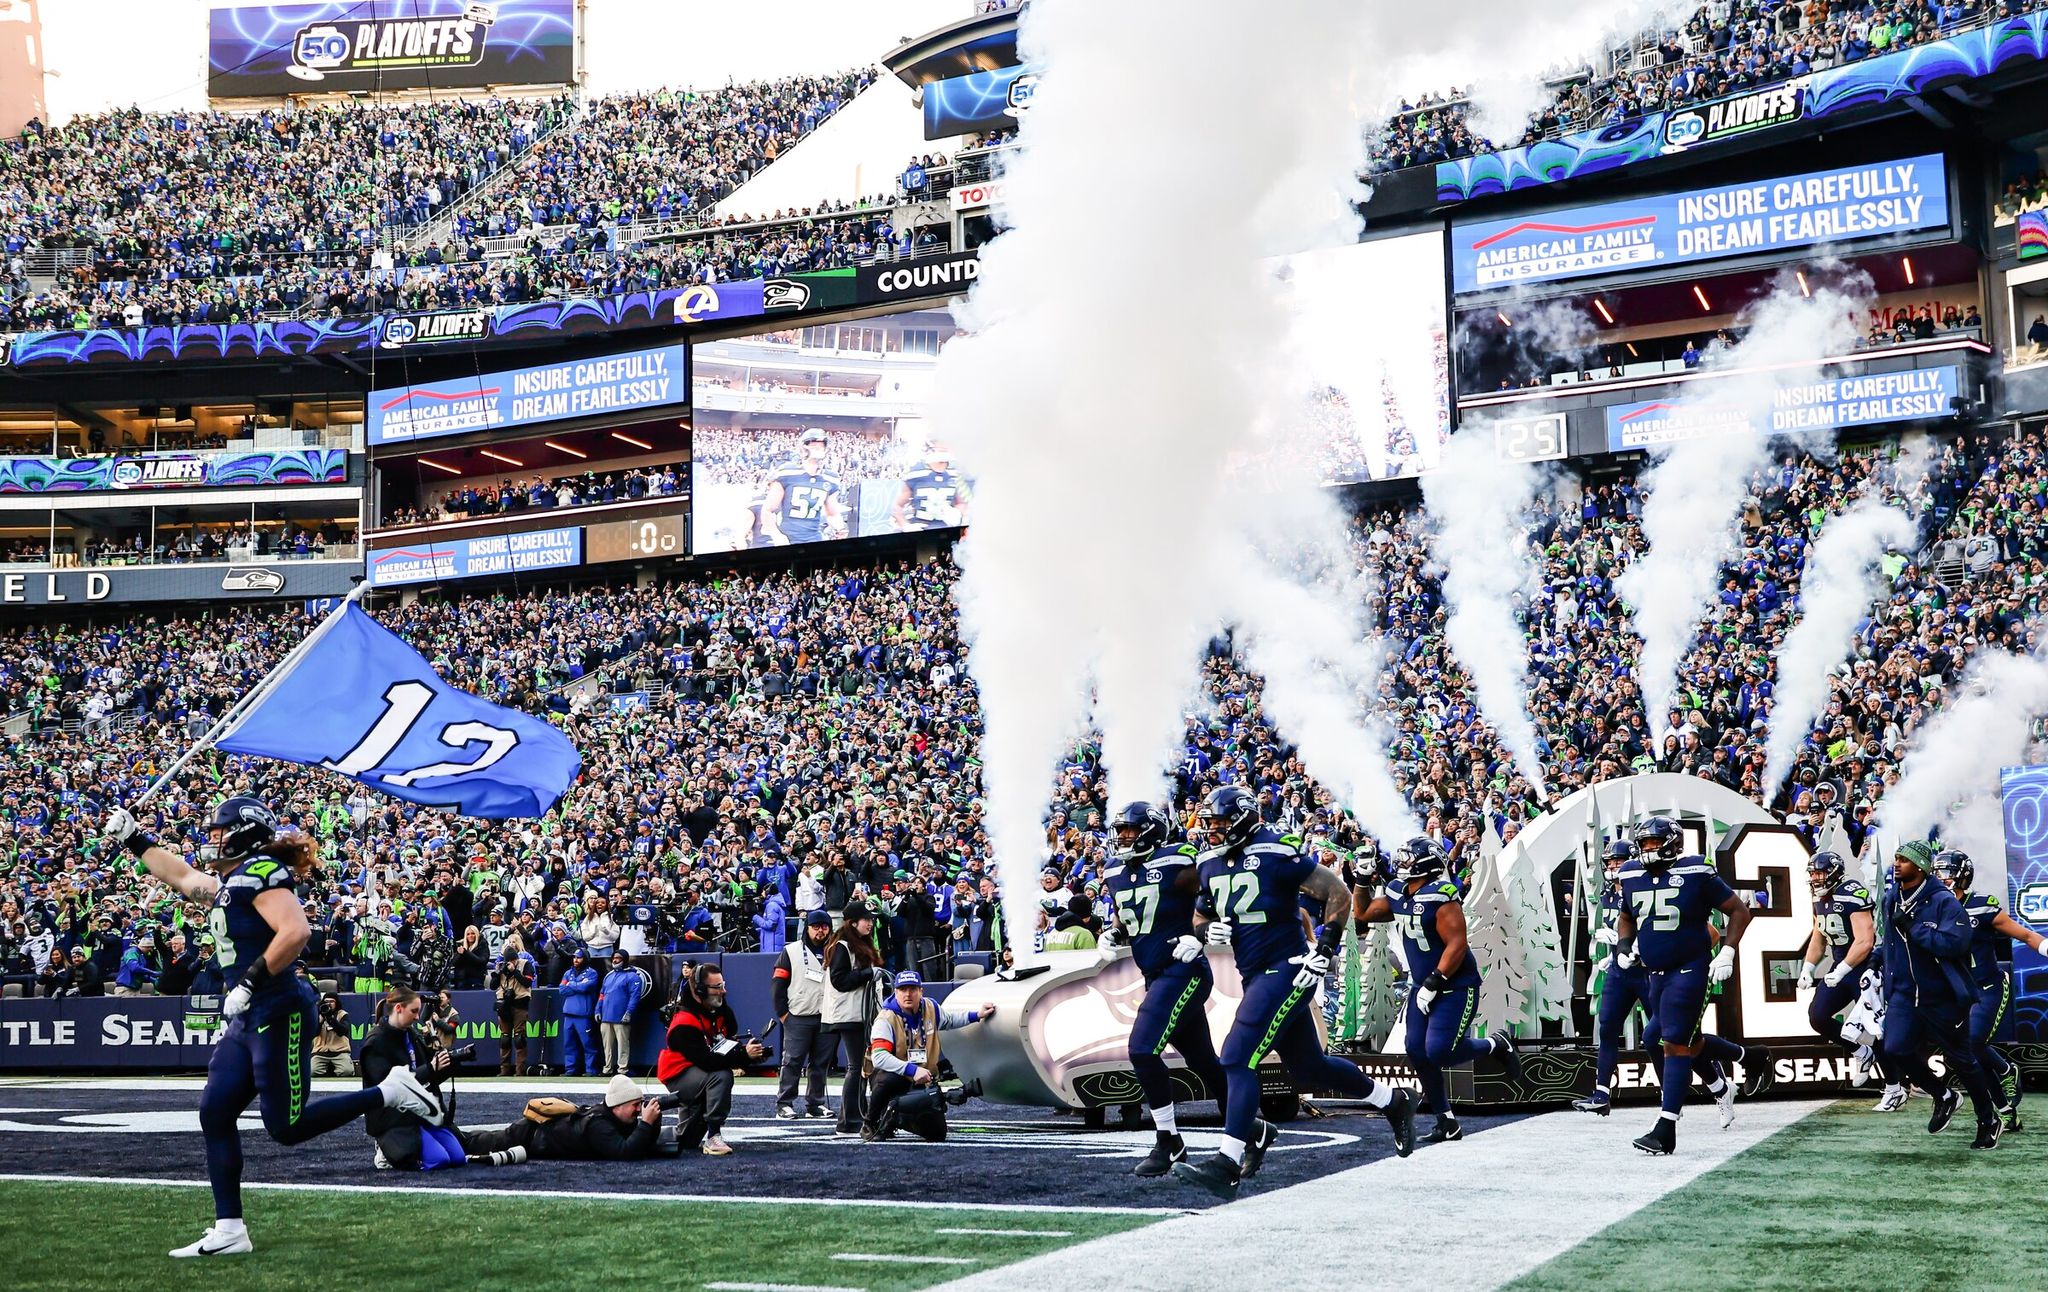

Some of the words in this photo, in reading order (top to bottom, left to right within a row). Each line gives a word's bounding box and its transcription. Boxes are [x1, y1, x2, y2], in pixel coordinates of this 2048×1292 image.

[302, 35, 346, 61] 50
[354, 20, 475, 59] PLAYOFFS
[1670, 118, 1703, 139] 50
[1708, 88, 1796, 133] PLAYOFFS
[905, 171, 921, 189] 12
[1678, 189, 1768, 224] INSURE
[1773, 165, 1919, 210] CAREFULLY,
[1677, 222, 1765, 256] DREAM
[1769, 196, 1923, 243] FEARLESSLY
[1478, 237, 1572, 268] AMERICAN
[1583, 227, 1653, 255] FAMILY
[877, 258, 981, 293] COUNTD
[1491, 249, 1640, 279] INSURANCE
[389, 324, 413, 338] 50
[417, 313, 485, 337] PLAYOFFS
[514, 367, 573, 396] INSURE
[575, 352, 668, 387] CAREFULLY,
[1774, 384, 1838, 407] INSURE
[1841, 370, 1943, 400] CAREFULLY,
[383, 404, 448, 425] AMERICAN
[451, 396, 500, 415] FAMILY
[512, 392, 568, 421] DREAM
[571, 377, 671, 412] FEARLESSLY
[1772, 404, 1834, 430] DREAM
[1839, 393, 1945, 424] FEARLESSLY
[391, 413, 489, 434] INSURANCE
[1622, 413, 1695, 436] AMERICAN
[1508, 420, 1556, 459] 25
[143, 460, 204, 479] PLAYOFFS
[469, 537, 508, 556] INSURE
[509, 530, 572, 552] CAREFULLY,
[375, 559, 422, 575] AMERICAN
[423, 555, 455, 570] FAMILY
[467, 555, 506, 574] DREAM
[506, 546, 573, 568] FEARLESSLY
[312, 598, 330, 617] 12
[320, 678, 520, 788] 12
[1185, 758, 1201, 775] 71
[1147, 872, 1162, 881] 50
[1244, 858, 1259, 868] 50
[1669, 876, 1684, 885] 50
[1210, 871, 1267, 924] 72
[1632, 887, 1680, 931] 75
[37, 939, 48, 953] 3
[490, 931, 508, 947] 24
[1392, 913, 1431, 952] 74
